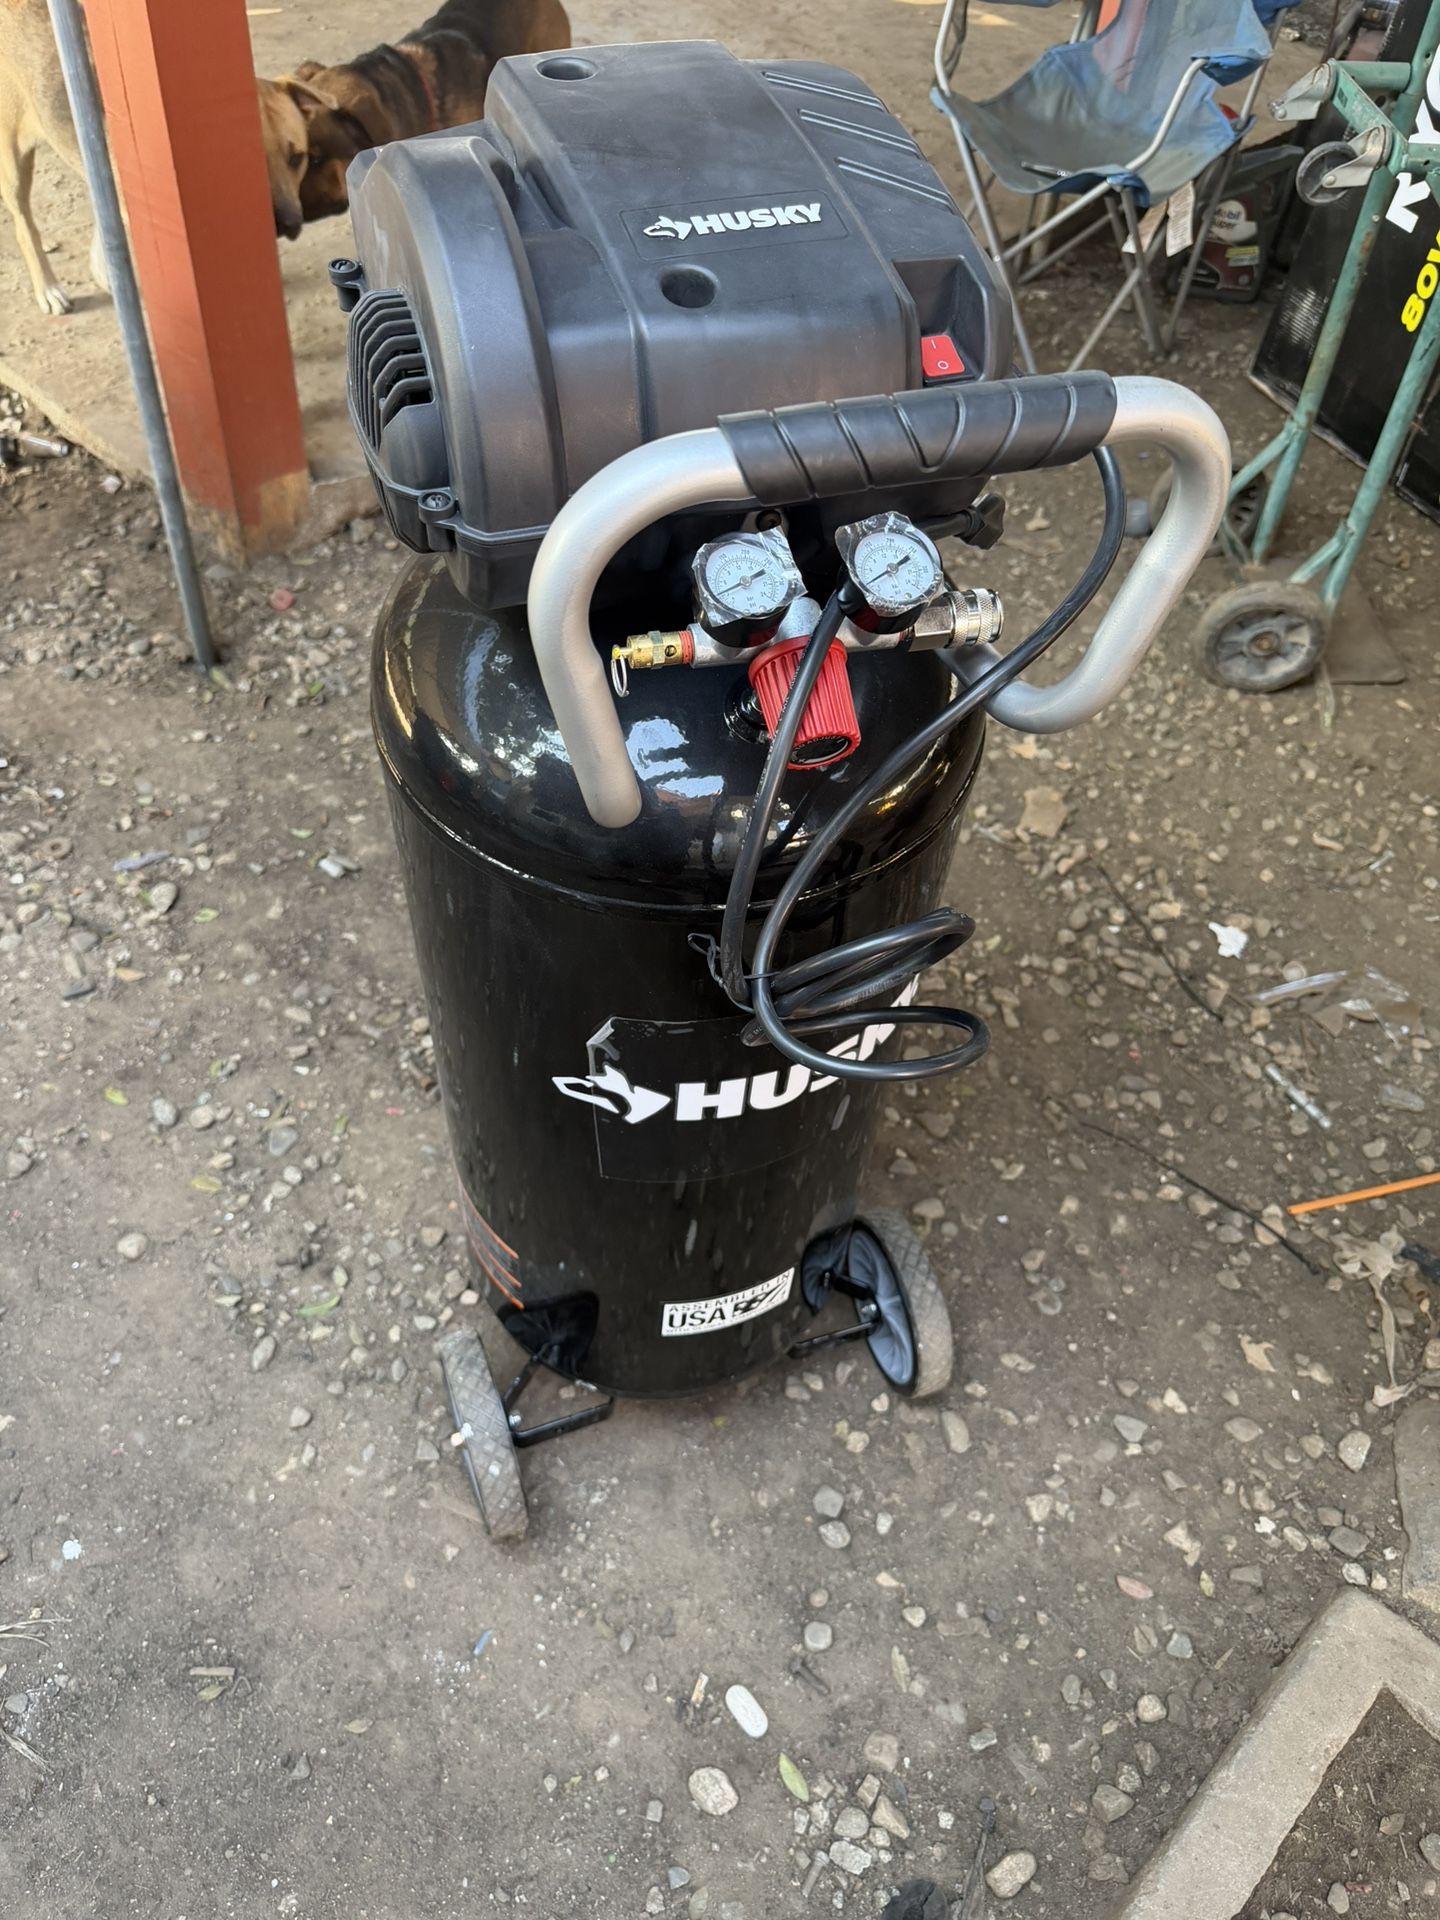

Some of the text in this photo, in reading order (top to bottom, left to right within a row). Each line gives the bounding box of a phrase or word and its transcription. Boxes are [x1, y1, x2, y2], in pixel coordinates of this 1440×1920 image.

[690, 203, 821, 235] HUSKY
[669, 1283, 770, 1312] ASSEMBLED
[777, 1270, 790, 1284] IN
[668, 1308, 726, 1328] USA
